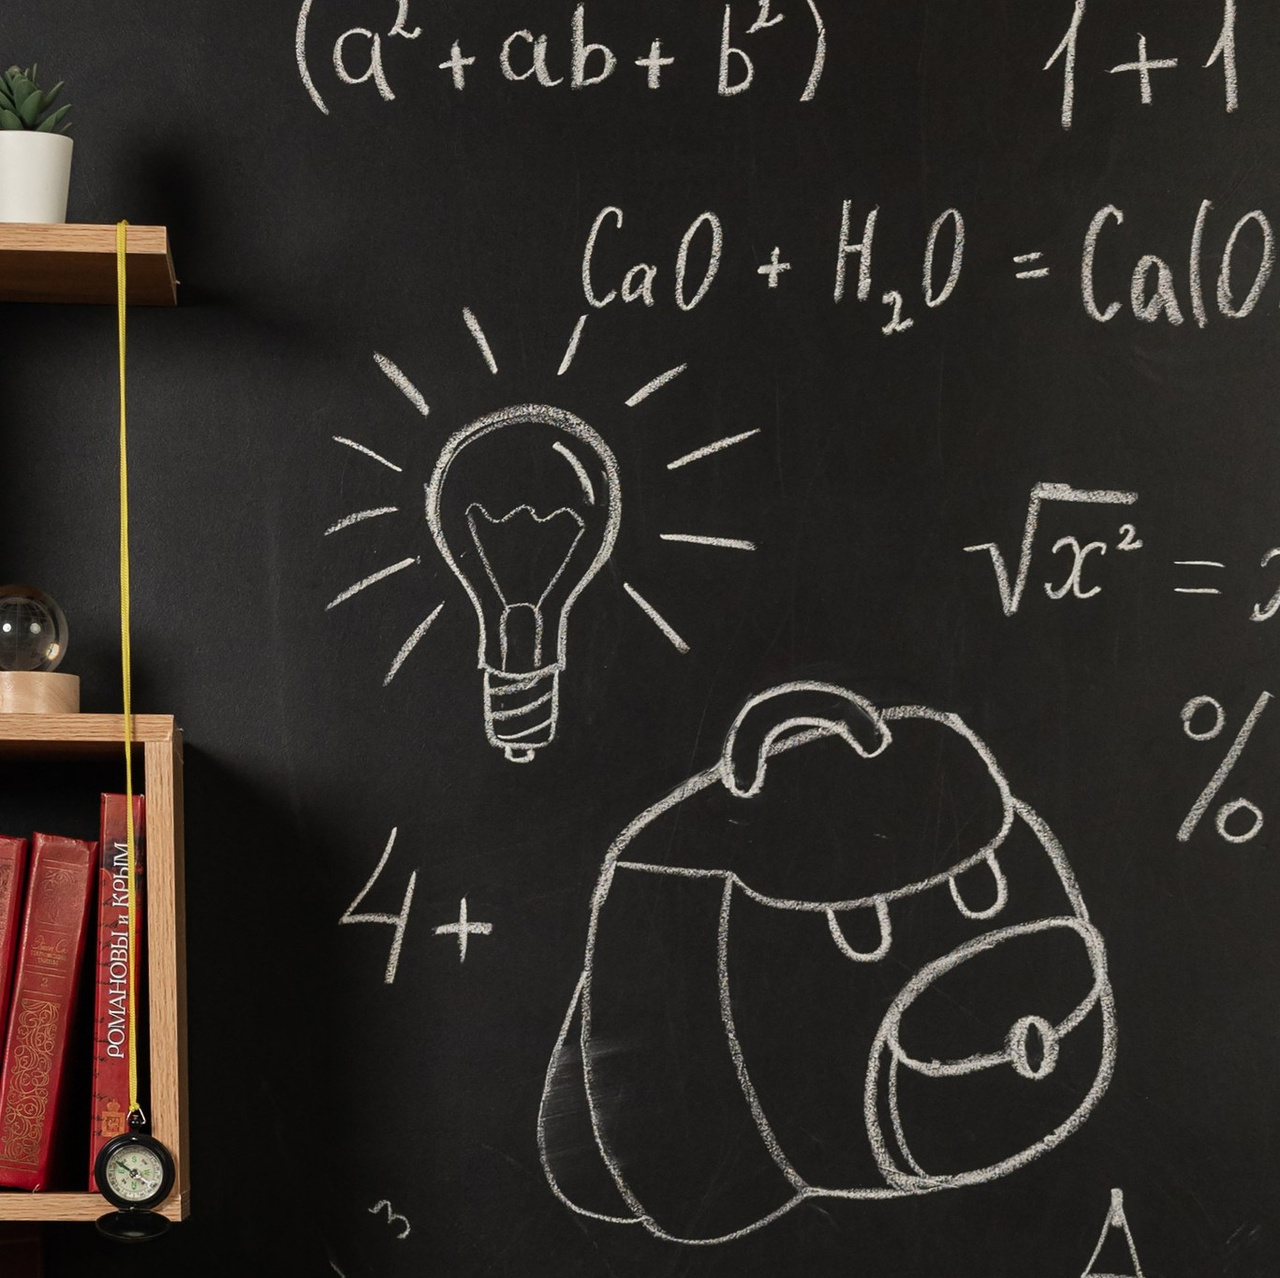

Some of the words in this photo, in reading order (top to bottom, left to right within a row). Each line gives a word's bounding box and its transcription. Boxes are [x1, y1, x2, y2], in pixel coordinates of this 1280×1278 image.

[582, 206, 722, 311] CaO
[112, 842, 130, 909] КРЫМ
[119, 914, 130, 926] и
[107, 931, 129, 1059] РОМАНОВЫ
